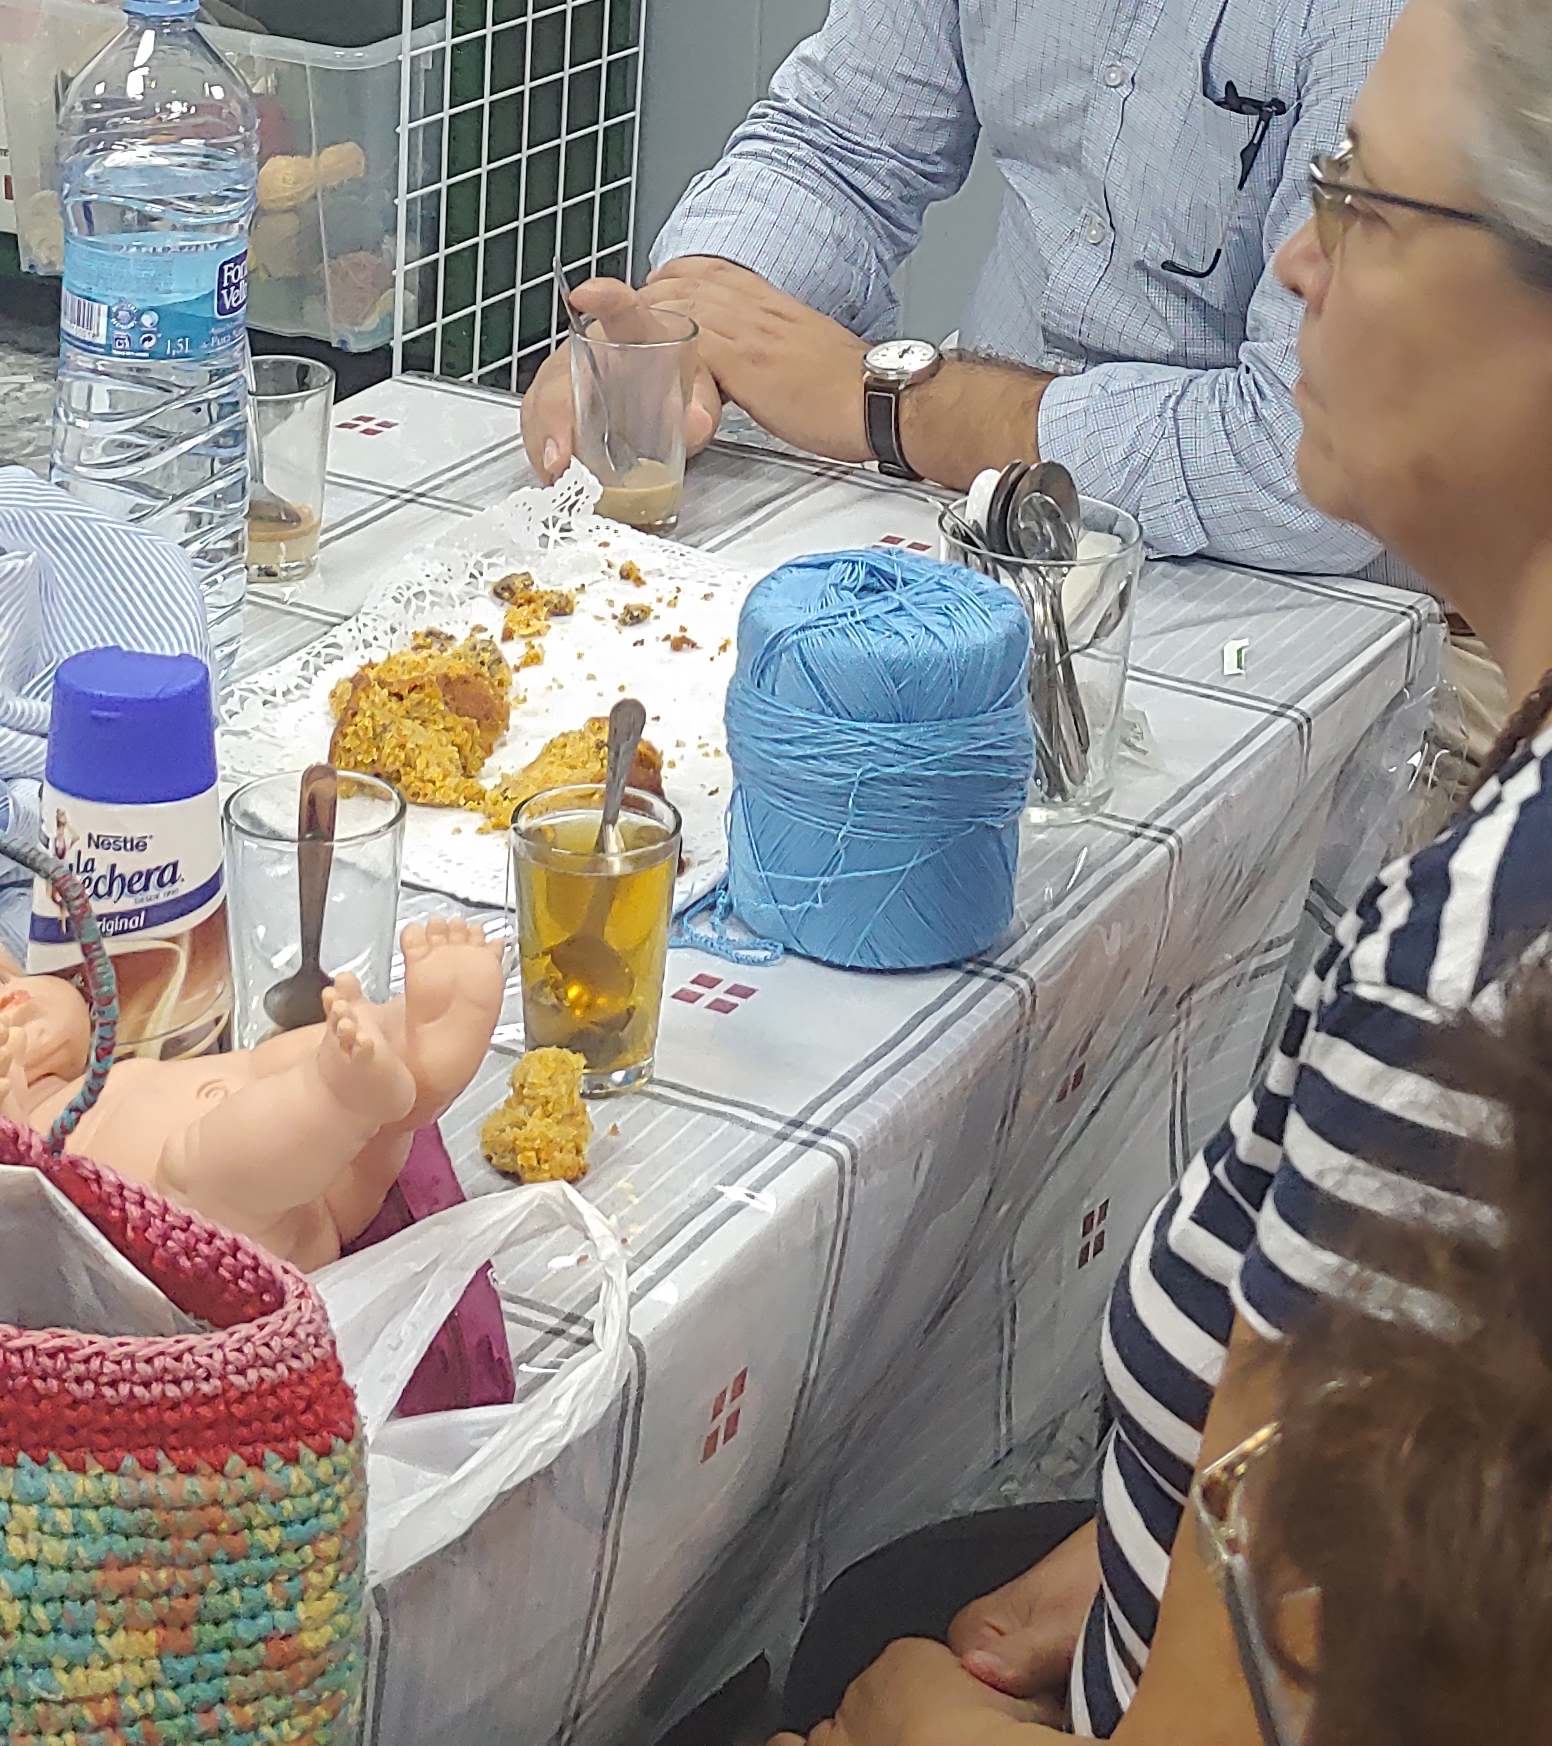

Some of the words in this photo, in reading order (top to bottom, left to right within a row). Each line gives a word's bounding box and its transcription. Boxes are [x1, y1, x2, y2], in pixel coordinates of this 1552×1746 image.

[222, 261, 247, 288] Fon
[221, 282, 248, 310] Vell
[81, 859, 182, 904] echera
[98, 910, 146, 937] iginal
